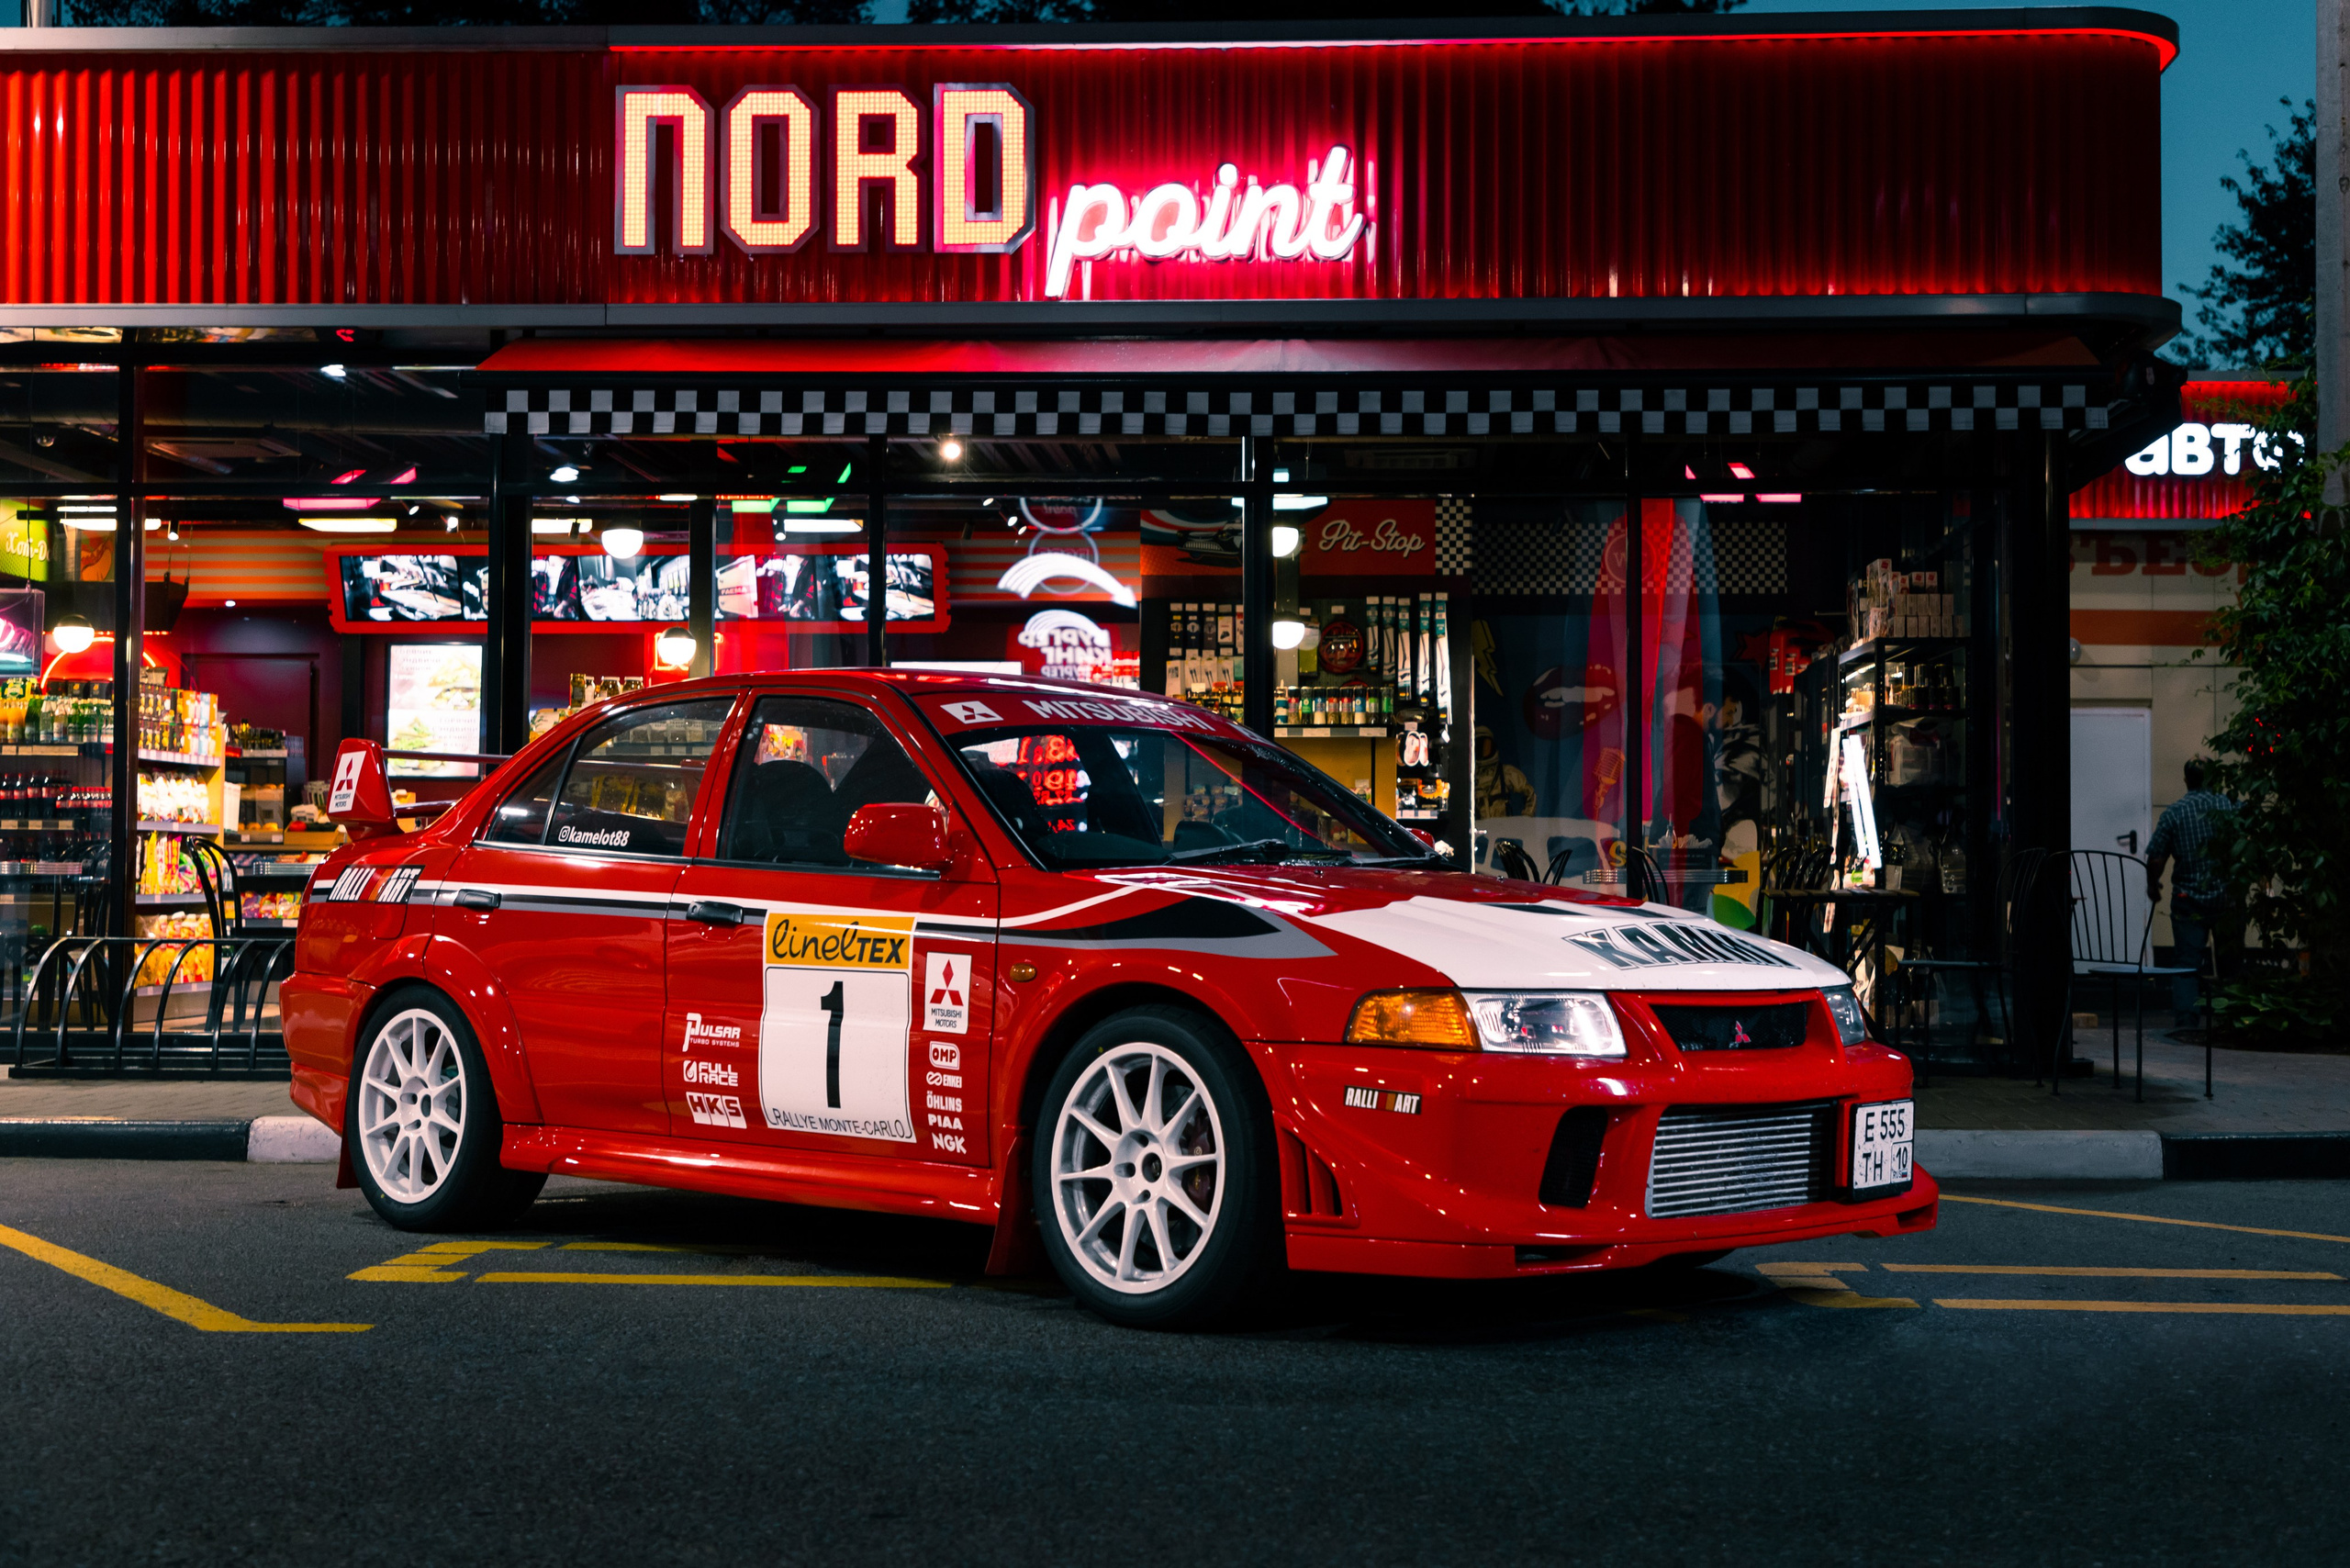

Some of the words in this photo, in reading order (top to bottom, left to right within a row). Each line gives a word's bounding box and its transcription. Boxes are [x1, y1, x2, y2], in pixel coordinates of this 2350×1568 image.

[615, 84, 1035, 254] NORD
[1045, 144, 1367, 299] point
[1318, 519, 1426, 558] Pit-Stop
[1022, 700, 1216, 732] MITSUBISHI
[328, 868, 376, 901] RALLI
[377, 868, 422, 902] ART
[931, 1007, 962, 1019] MITSUBISHI
[934, 1018, 957, 1028] MOTORS
[690, 1037, 710, 1046] TURBO
[711, 1039, 740, 1047] SYSTEMS
[821, 980, 844, 1109] 1
[932, 1047, 957, 1063] OMP
[699, 1061, 738, 1075] FULL
[699, 1072, 738, 1087] RACE
[943, 1074, 962, 1088] ENKEI
[688, 1094, 743, 1118] HKS
[926, 1090, 962, 1113] ÖHLINS
[1345, 1087, 1379, 1109] RALLI
[1393, 1093, 1420, 1114] ART
[772, 1108, 818, 1129] RALLYE
[819, 1117, 905, 1138] MONTE-CARLO
[927, 1114, 963, 1130] PIAA
[1880, 1108, 1905, 1140] 555
[932, 1132, 967, 1155] NGK
[1896, 1147, 1908, 1170] 10
[1893, 1170, 1902, 1180] RUS
